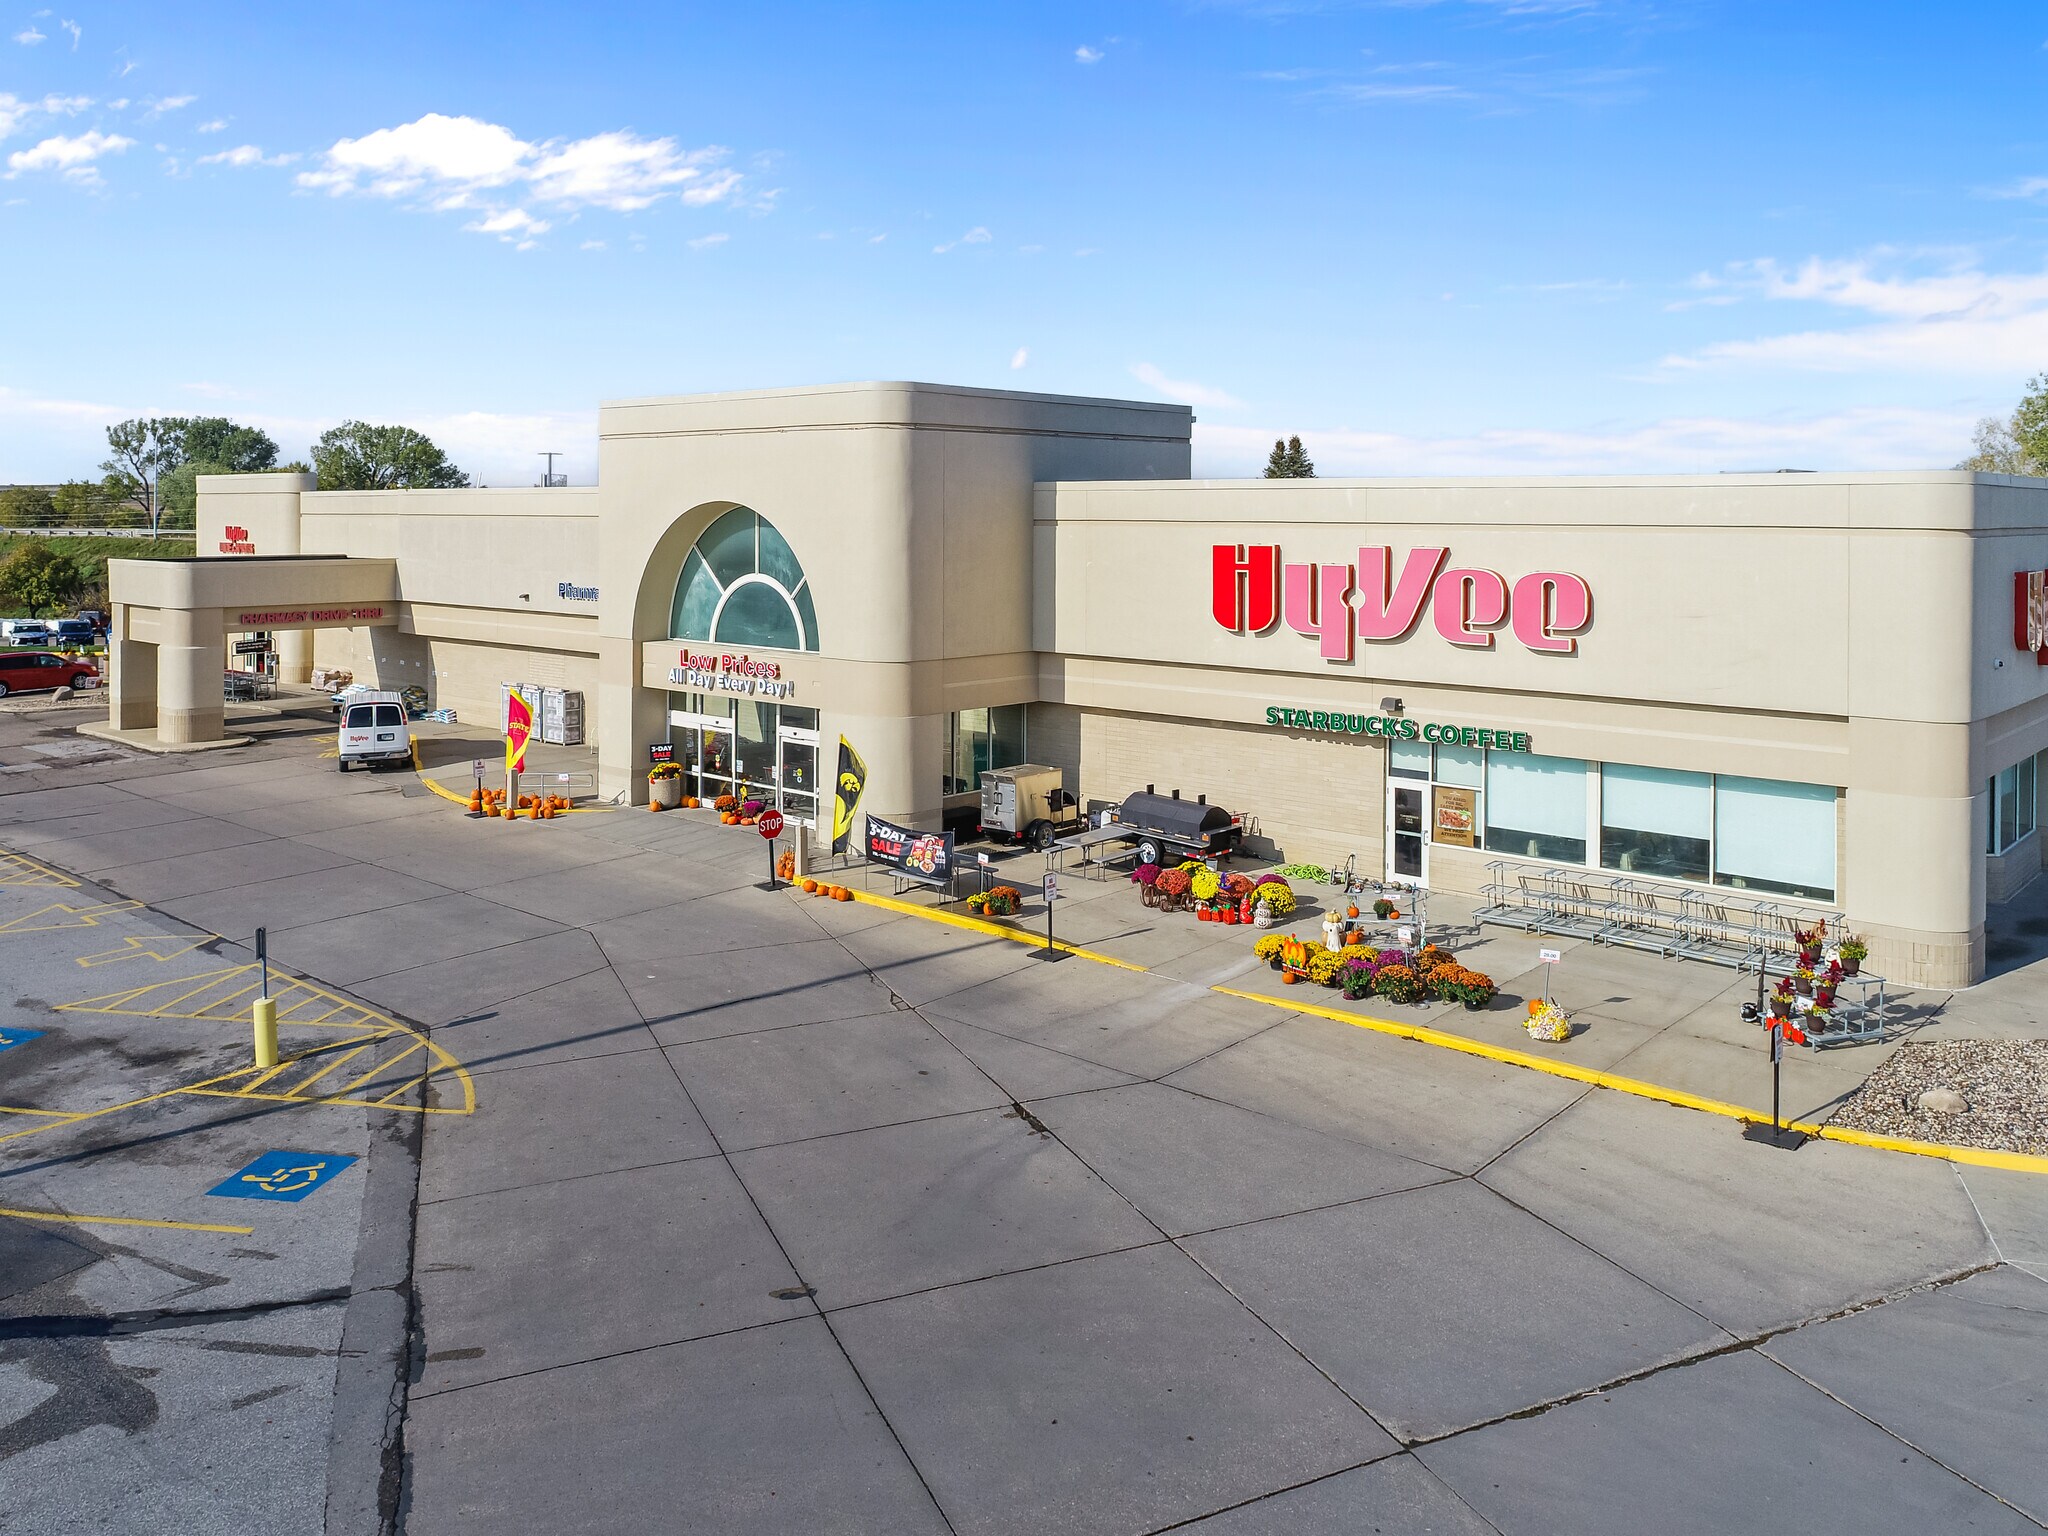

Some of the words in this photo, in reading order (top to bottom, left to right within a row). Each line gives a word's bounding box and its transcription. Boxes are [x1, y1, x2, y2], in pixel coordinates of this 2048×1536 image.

[241, 612, 309, 624] PHARMACY
[680, 649, 717, 672] Low
[721, 654, 780, 679] Prices
[668, 668, 687, 684] All
[688, 670, 715, 691] Day
[716, 673, 755, 695] Every
[509, 721, 530, 733] STATE
[1266, 706, 1418, 740] STARBUCKS
[1422, 722, 1531, 753] COFFEE
[760, 817, 782, 832] STOP
[872, 838, 902, 856] SALE
